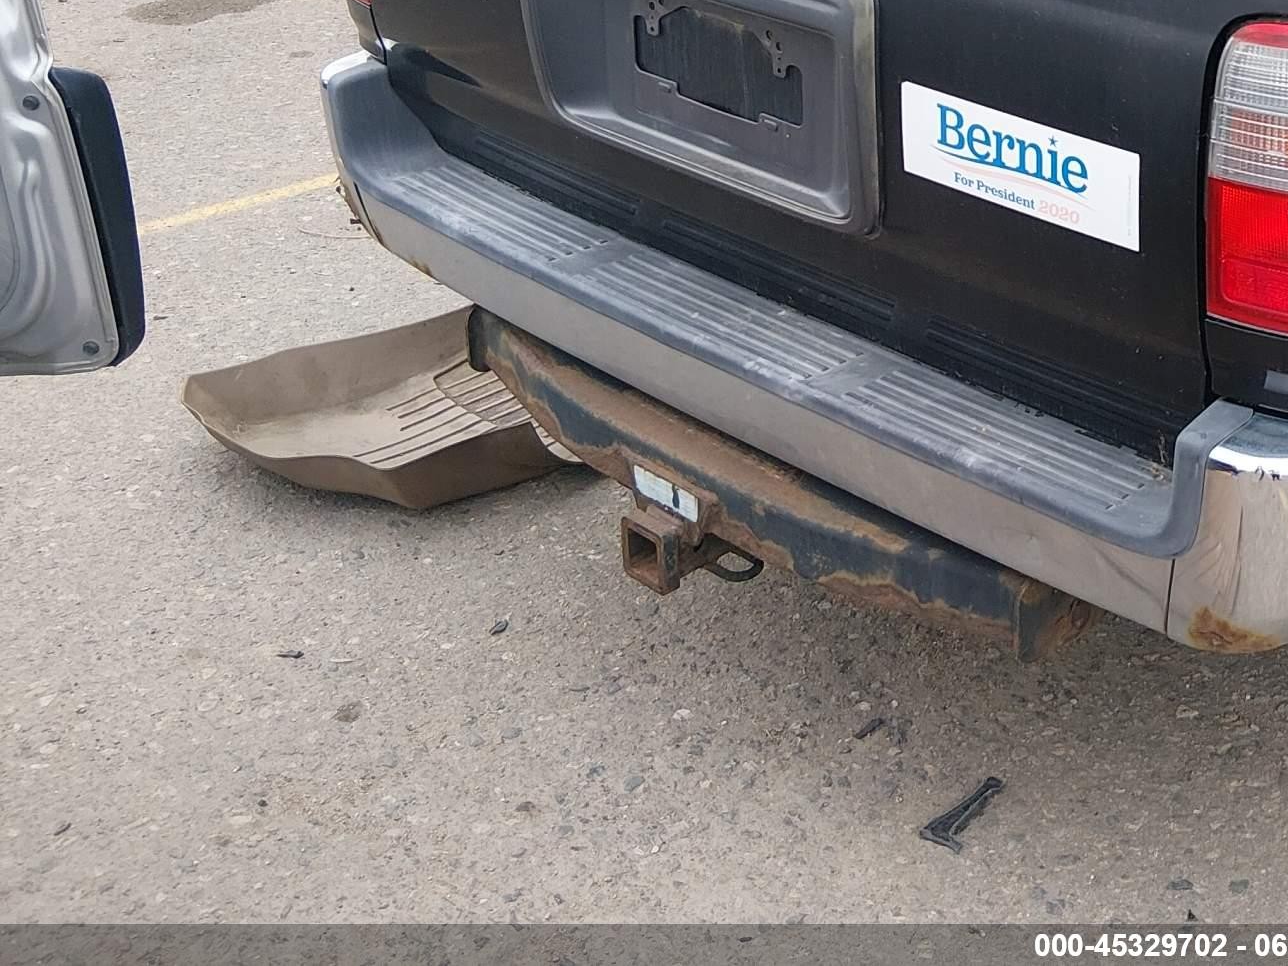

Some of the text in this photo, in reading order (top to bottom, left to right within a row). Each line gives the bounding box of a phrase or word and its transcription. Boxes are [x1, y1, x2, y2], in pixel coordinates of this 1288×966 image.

[936, 102, 1089, 194] Bernie
[953, 171, 1081, 225] For President 2020
